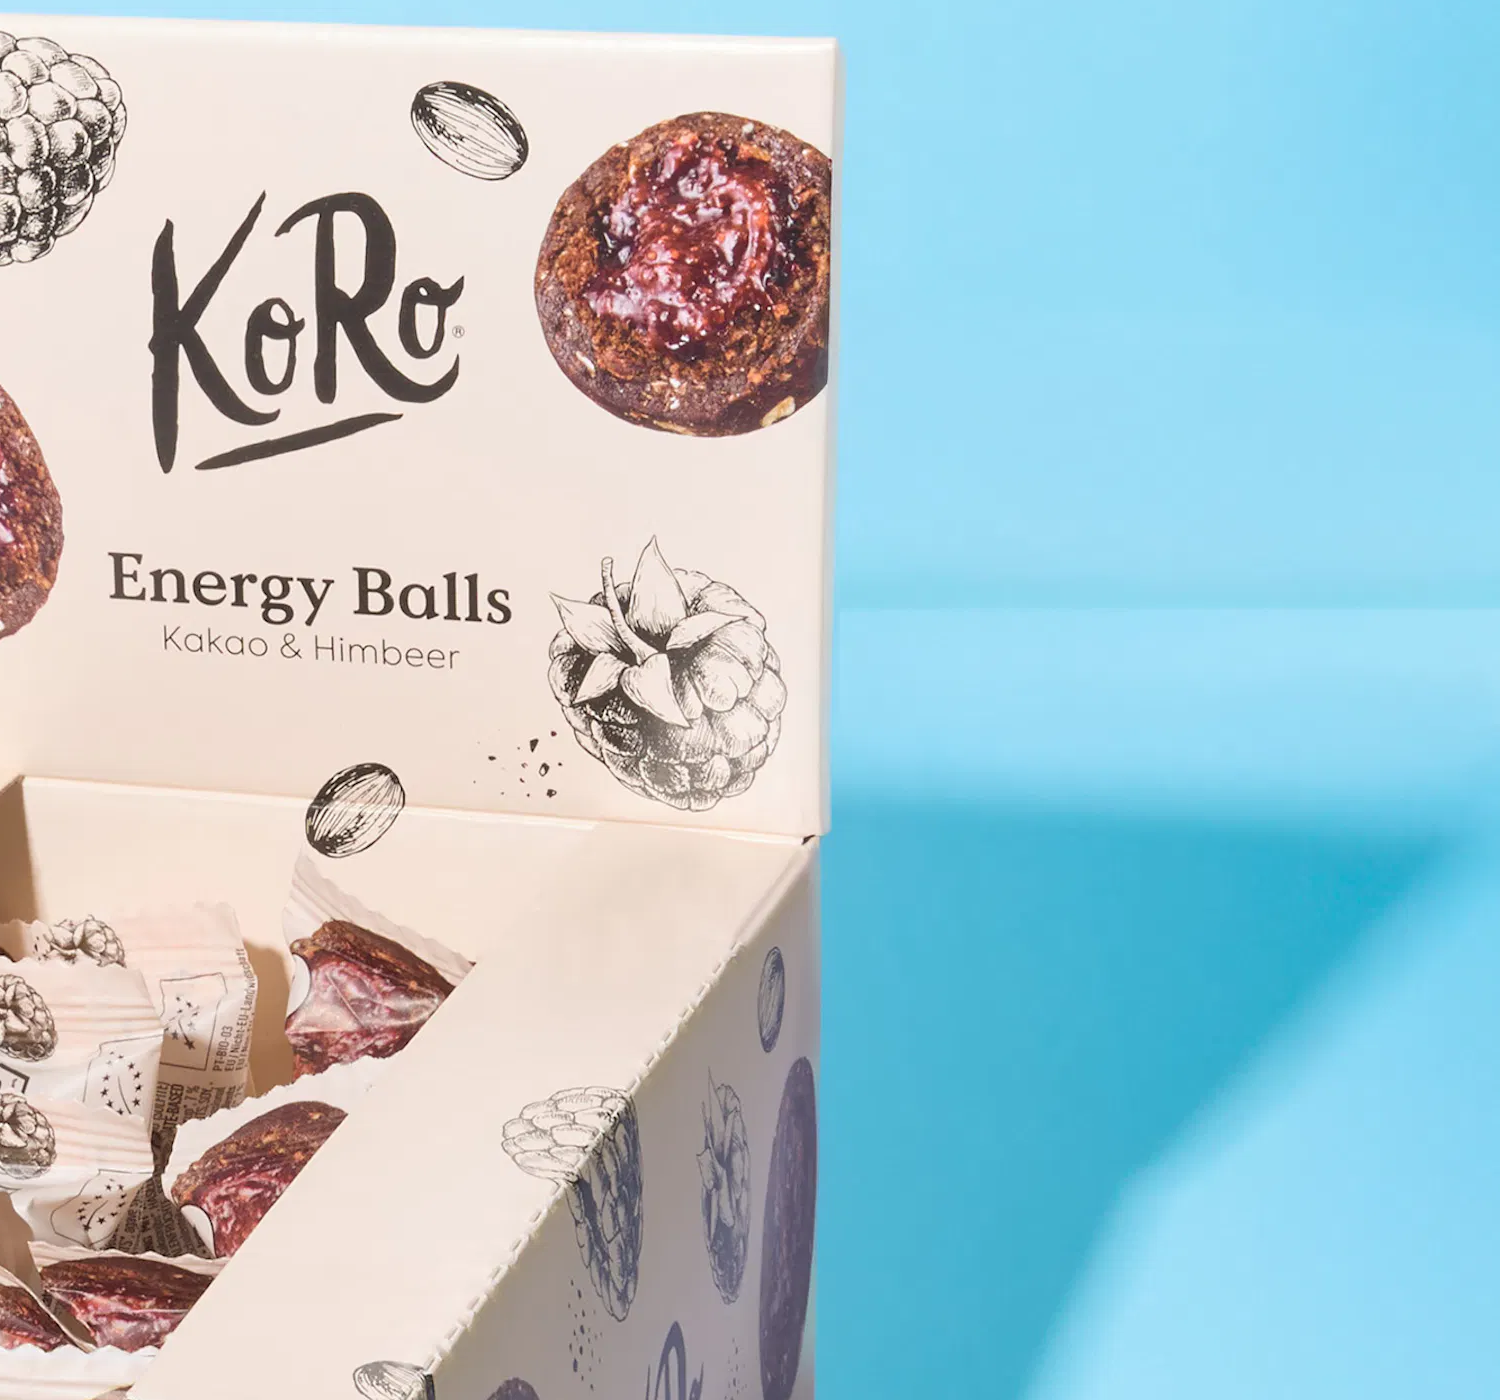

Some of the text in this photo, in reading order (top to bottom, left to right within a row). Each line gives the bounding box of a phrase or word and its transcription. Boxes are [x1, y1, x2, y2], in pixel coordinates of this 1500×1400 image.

[151, 190, 463, 474] KoRo
[108, 552, 513, 626] Energy Balls
[163, 625, 460, 669] Kakao & Himbeer
